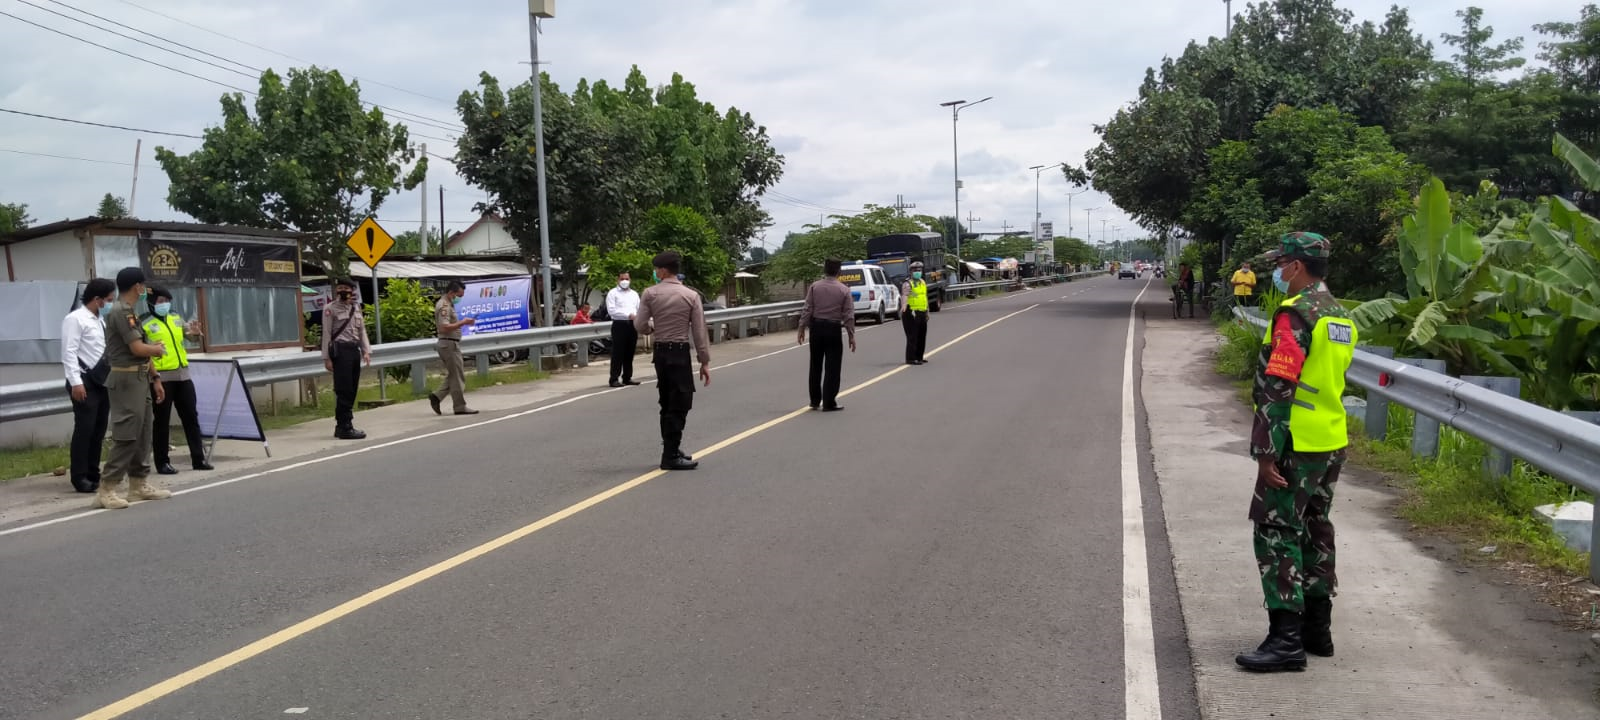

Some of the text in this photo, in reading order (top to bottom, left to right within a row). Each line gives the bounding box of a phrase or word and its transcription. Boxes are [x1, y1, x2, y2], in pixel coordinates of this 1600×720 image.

[154, 254, 175, 266] 234
[461, 299, 522, 316] OPERASI YUSTISI
